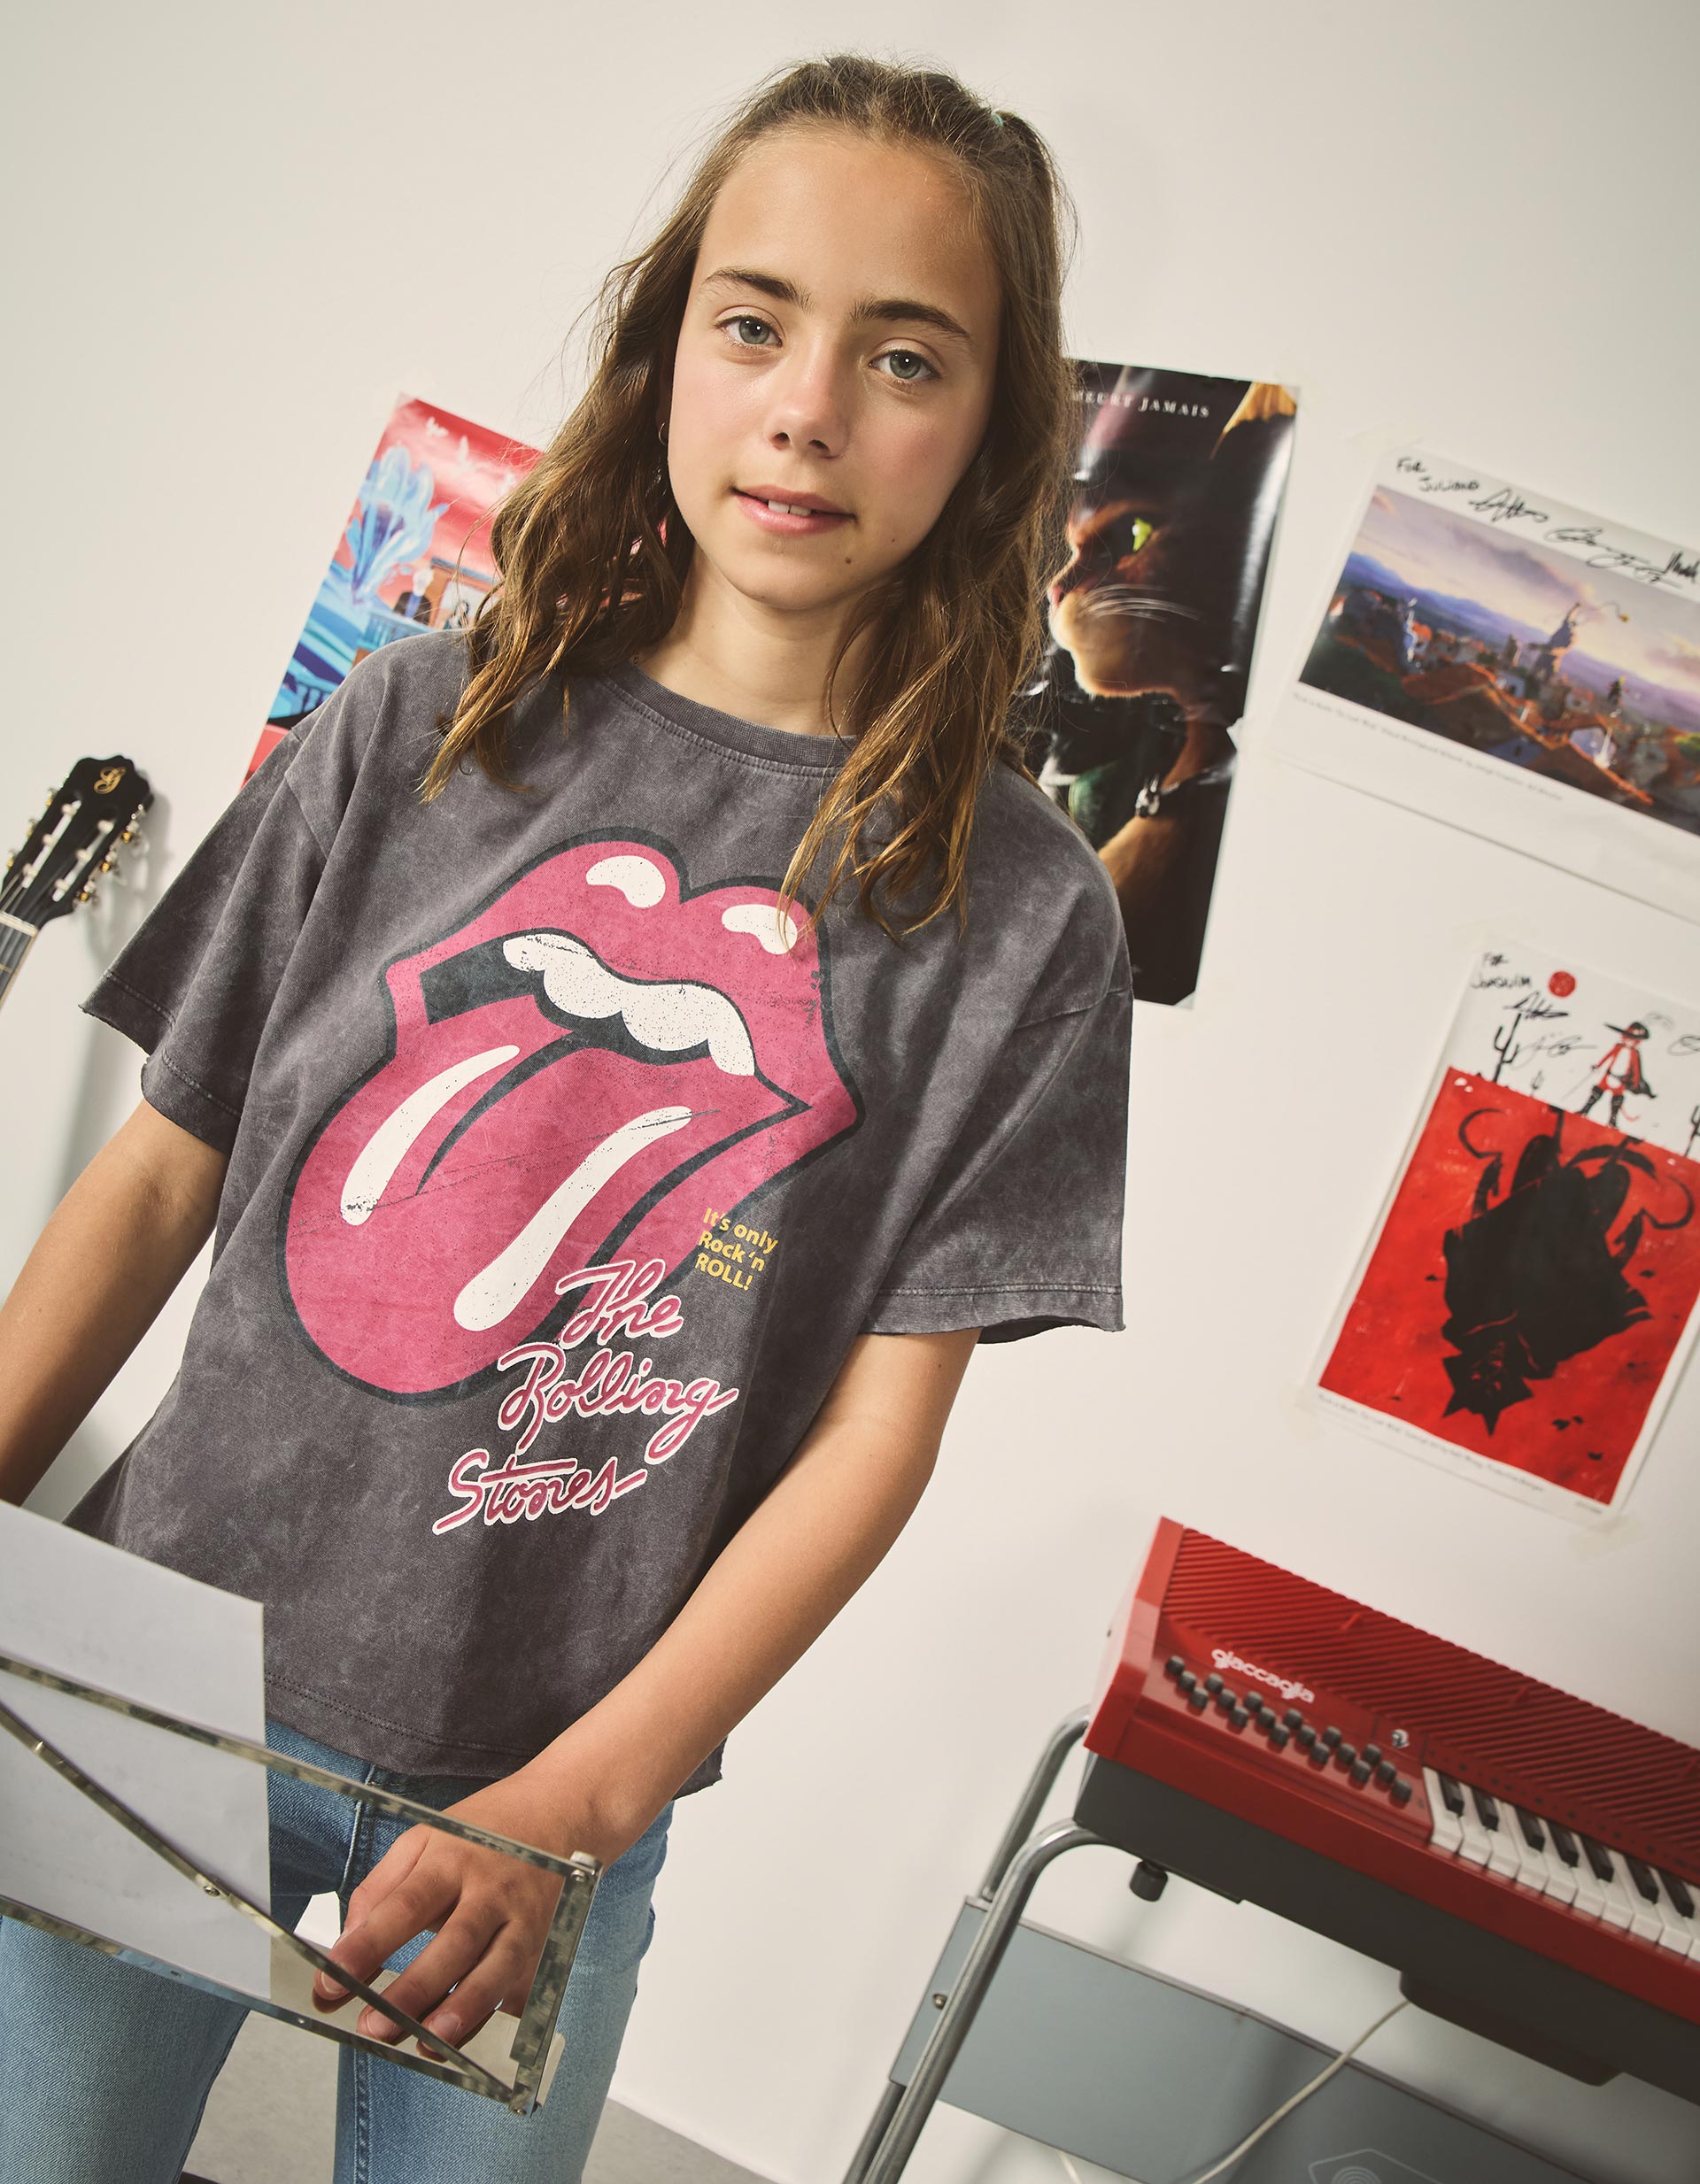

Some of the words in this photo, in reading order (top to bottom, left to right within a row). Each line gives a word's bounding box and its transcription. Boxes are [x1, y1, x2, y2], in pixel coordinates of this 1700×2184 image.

[1138, 396, 1210, 419] JAMAIS
[698, 1230, 746, 1263] Rock
[703, 1208, 731, 1231] It's
[733, 1223, 779, 1254] only
[694, 1252, 753, 1291] ROLL!
[555, 1259, 684, 1349] The
[498, 1341, 739, 1465] Rolling
[432, 1448, 648, 1536] Stones
